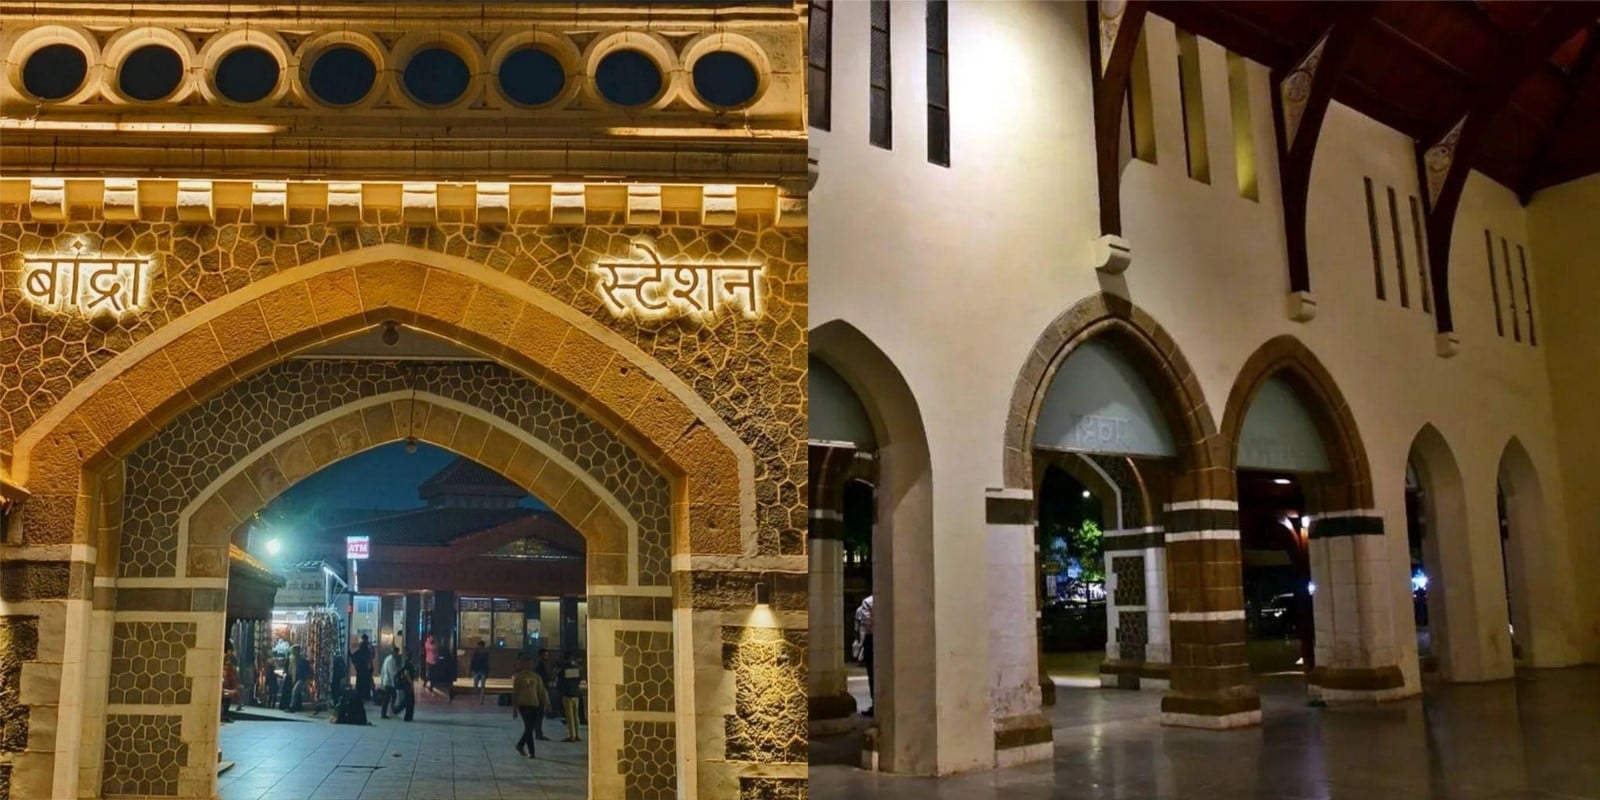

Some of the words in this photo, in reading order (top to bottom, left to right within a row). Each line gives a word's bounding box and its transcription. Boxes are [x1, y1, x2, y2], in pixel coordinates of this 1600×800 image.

[24, 240, 149, 311] बांद्रा
[598, 243, 762, 311] स्टेशन
[348, 543, 368, 552] ATM
